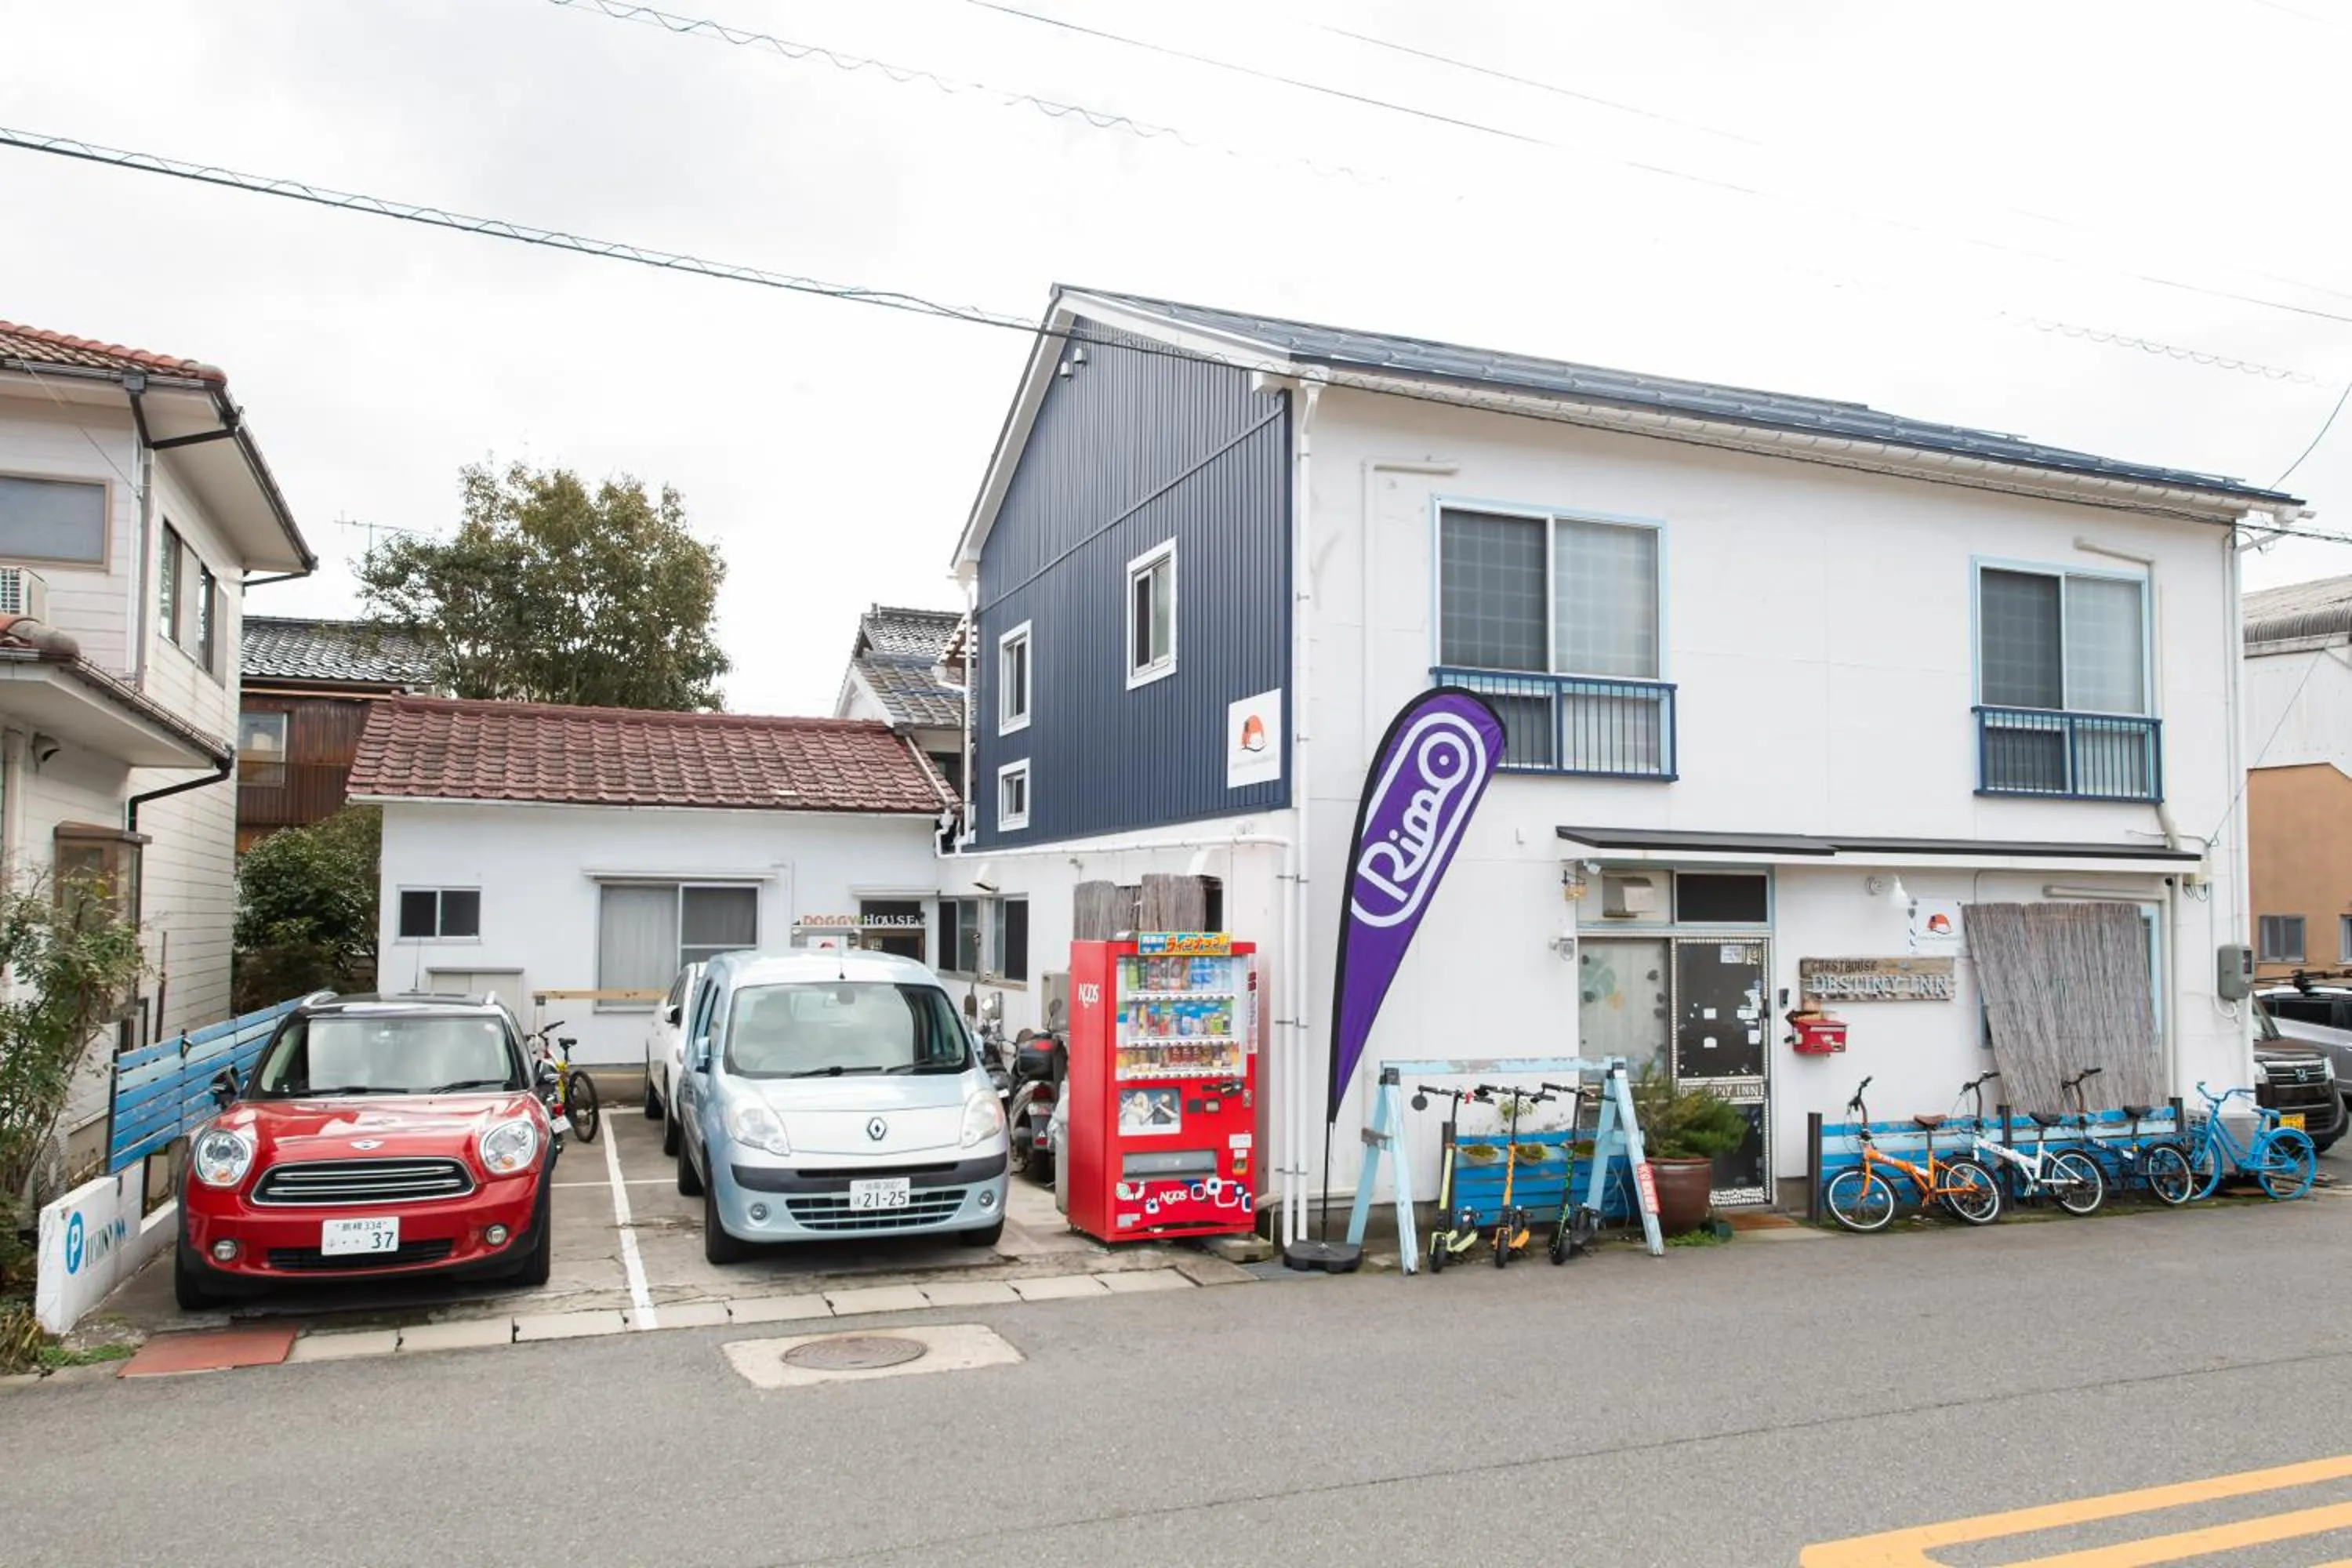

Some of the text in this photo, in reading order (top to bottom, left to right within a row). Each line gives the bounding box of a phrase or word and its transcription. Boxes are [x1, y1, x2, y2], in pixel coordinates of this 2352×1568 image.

[1357, 731, 1470, 902] Rimo
[804, 913, 915, 926] DOGGY HOUSE
[1811, 960, 1878, 973] GUESTHOUSE
[1811, 975, 1948, 996] DESTINY INN
[1737, 1084, 1759, 1097] INN
[863, 1191, 906, 1207] 21-25
[371, 1232, 394, 1250] 37
